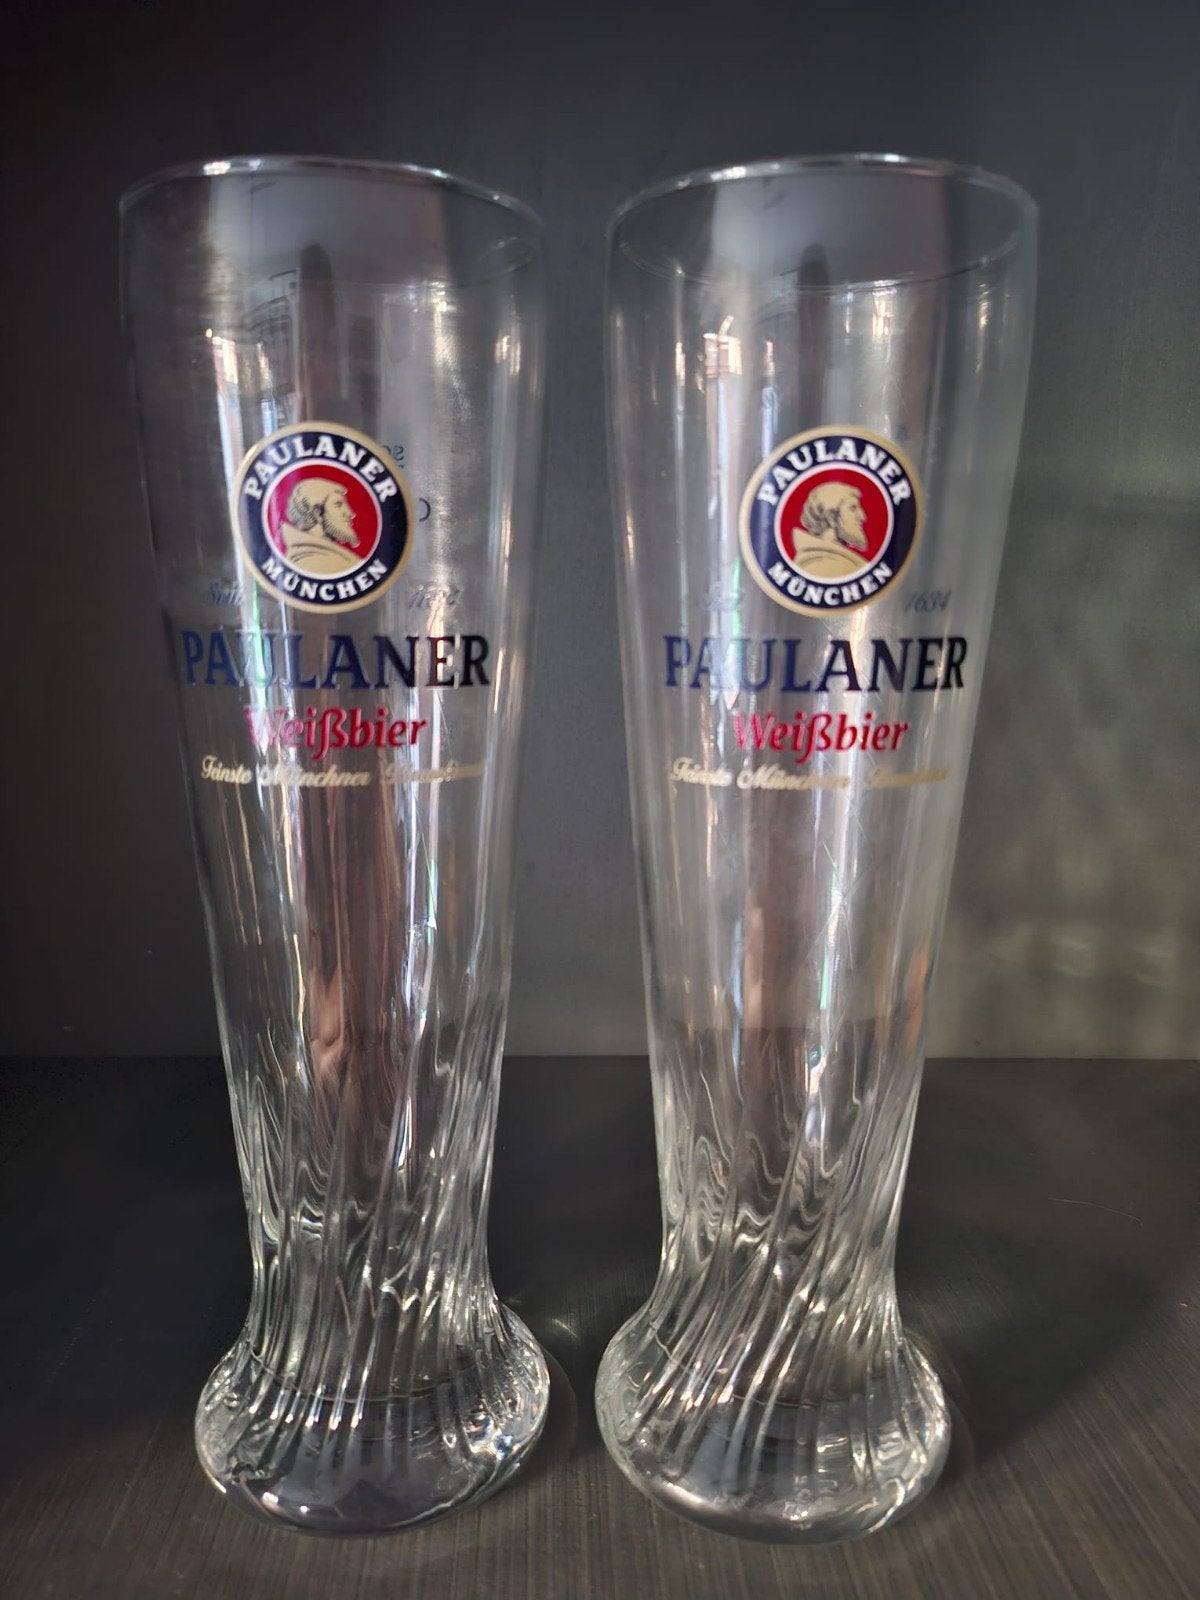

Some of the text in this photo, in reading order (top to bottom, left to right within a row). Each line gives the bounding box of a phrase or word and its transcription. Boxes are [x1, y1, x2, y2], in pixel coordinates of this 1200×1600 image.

[243, 435, 399, 503] PAULANER
[757, 438, 912, 505] PAULANER
[261, 557, 389, 602] MÜNCHEN
[768, 562, 893, 607] MÜNCHEN
[180, 630, 491, 691] PAULANER
[662, 635, 969, 693] PAULANER
[243, 705, 428, 762] Weißbier
[732, 711, 910, 765] Weißbier
